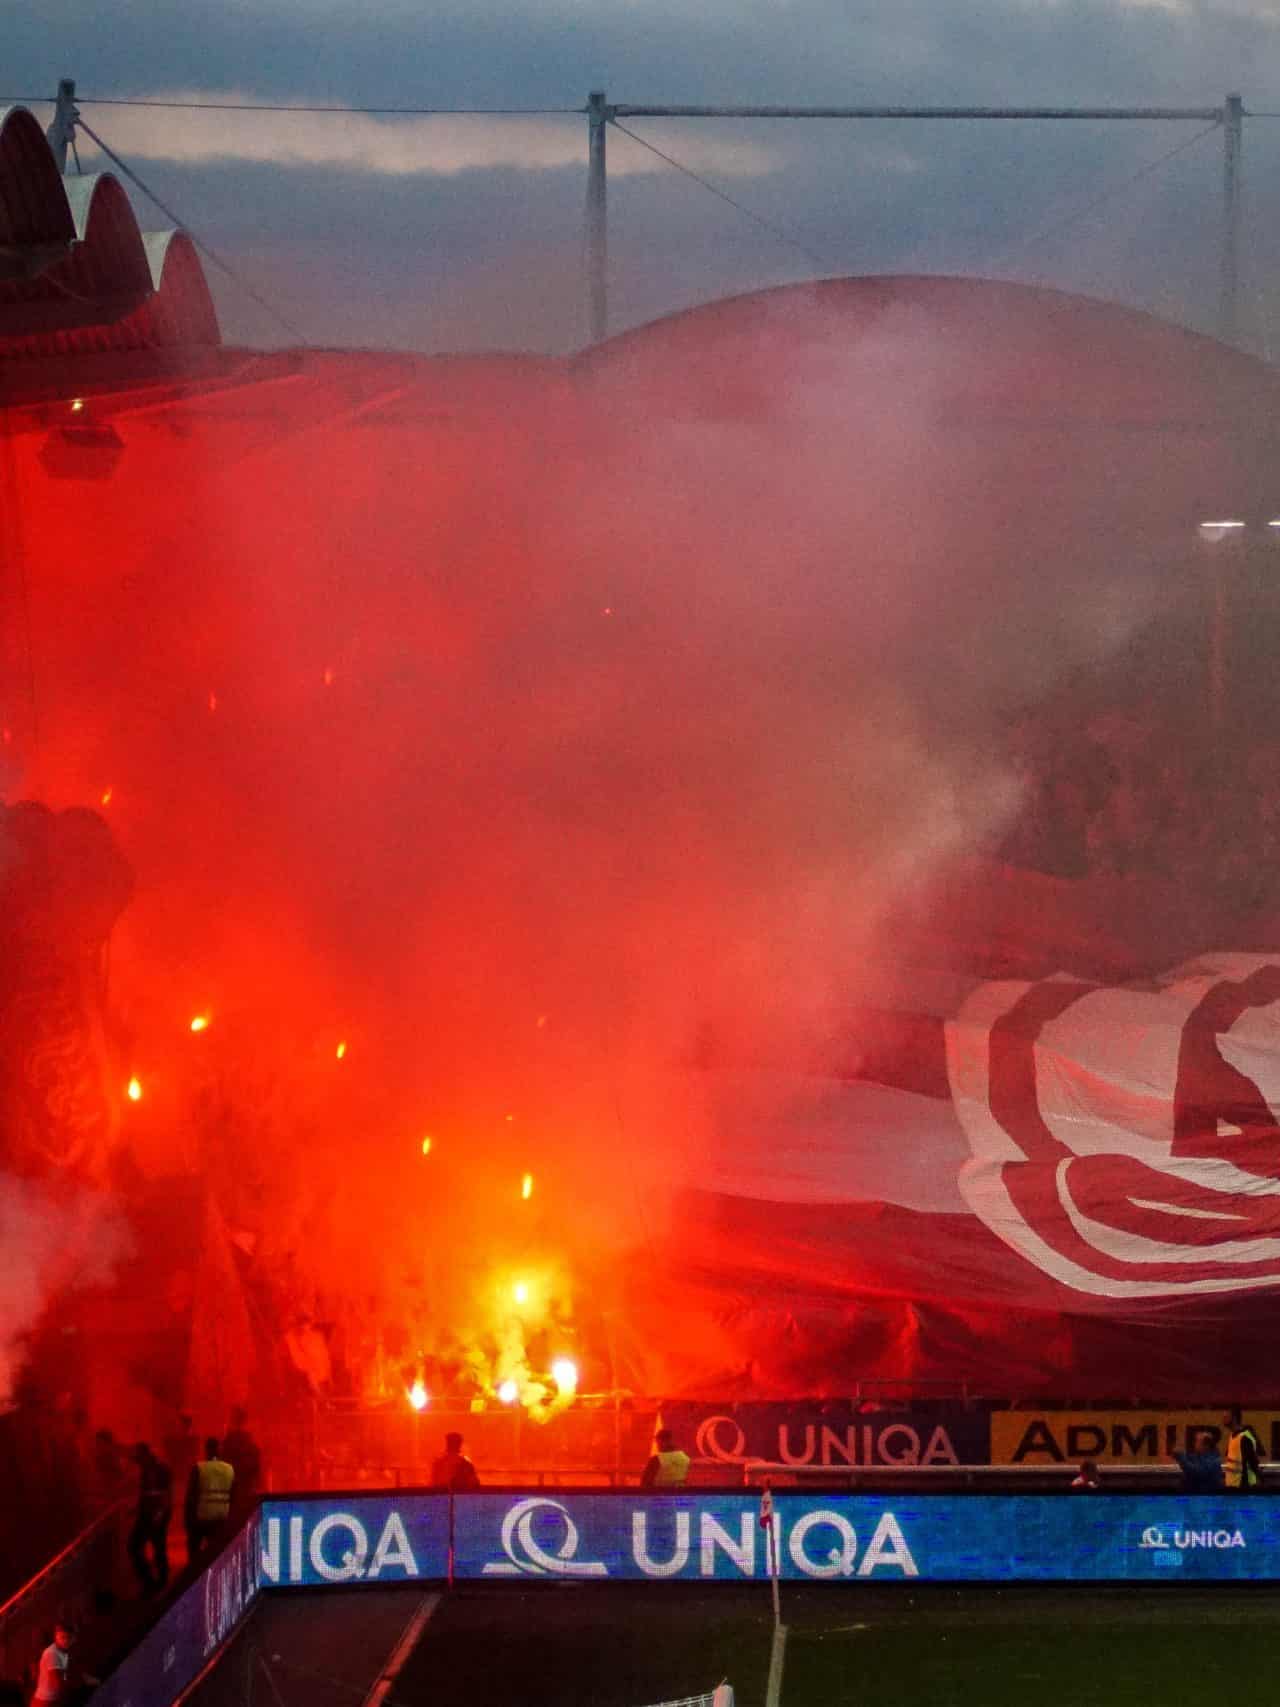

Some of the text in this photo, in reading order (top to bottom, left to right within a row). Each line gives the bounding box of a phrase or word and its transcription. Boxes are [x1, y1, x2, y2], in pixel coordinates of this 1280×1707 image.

[778, 1423, 960, 1466] UNIQA
[631, 1510, 919, 1577] UNIQA
[1174, 1529, 1246, 1549] UNIQA
